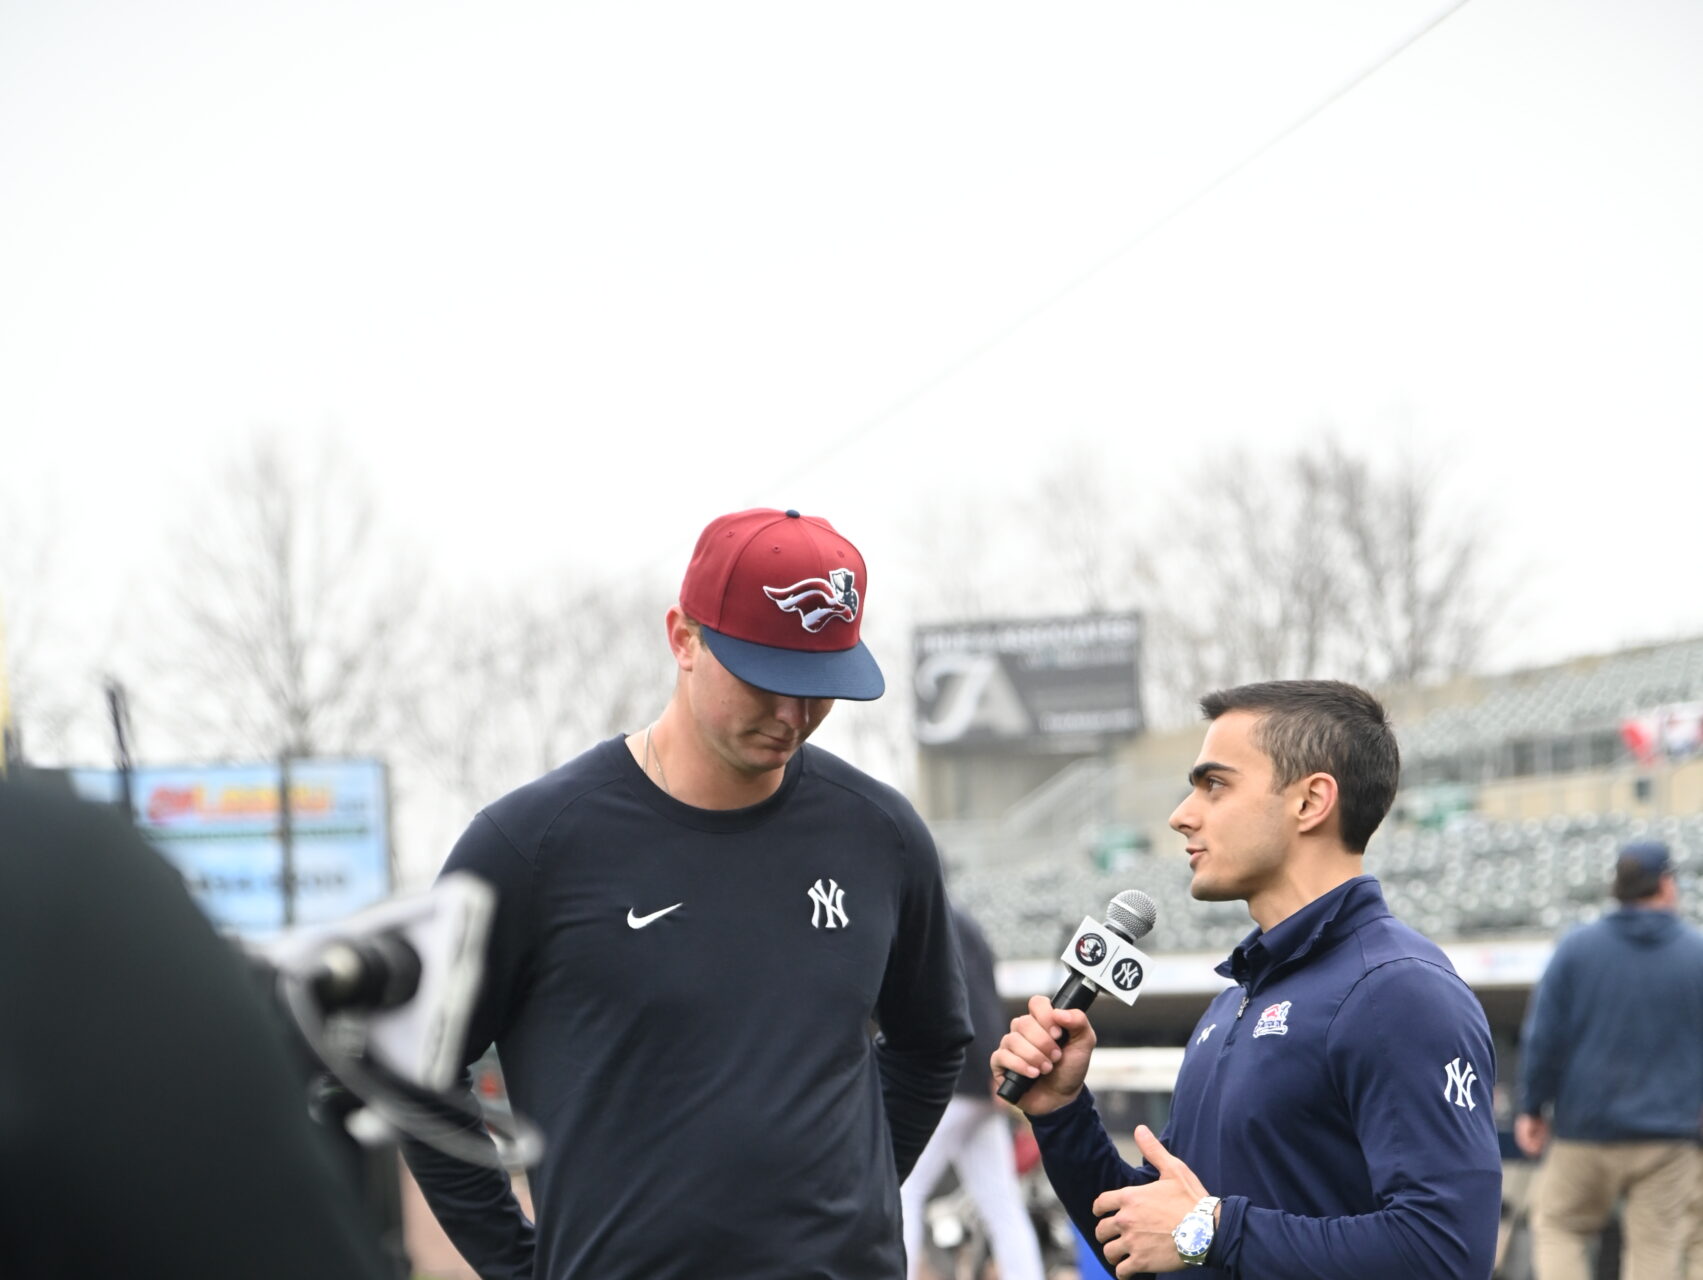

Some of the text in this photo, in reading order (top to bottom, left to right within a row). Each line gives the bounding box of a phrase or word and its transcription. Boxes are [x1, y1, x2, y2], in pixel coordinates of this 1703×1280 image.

[807, 878, 849, 929] NY
[1114, 961, 1139, 989] NY
[1443, 1057, 1477, 1112] NY
